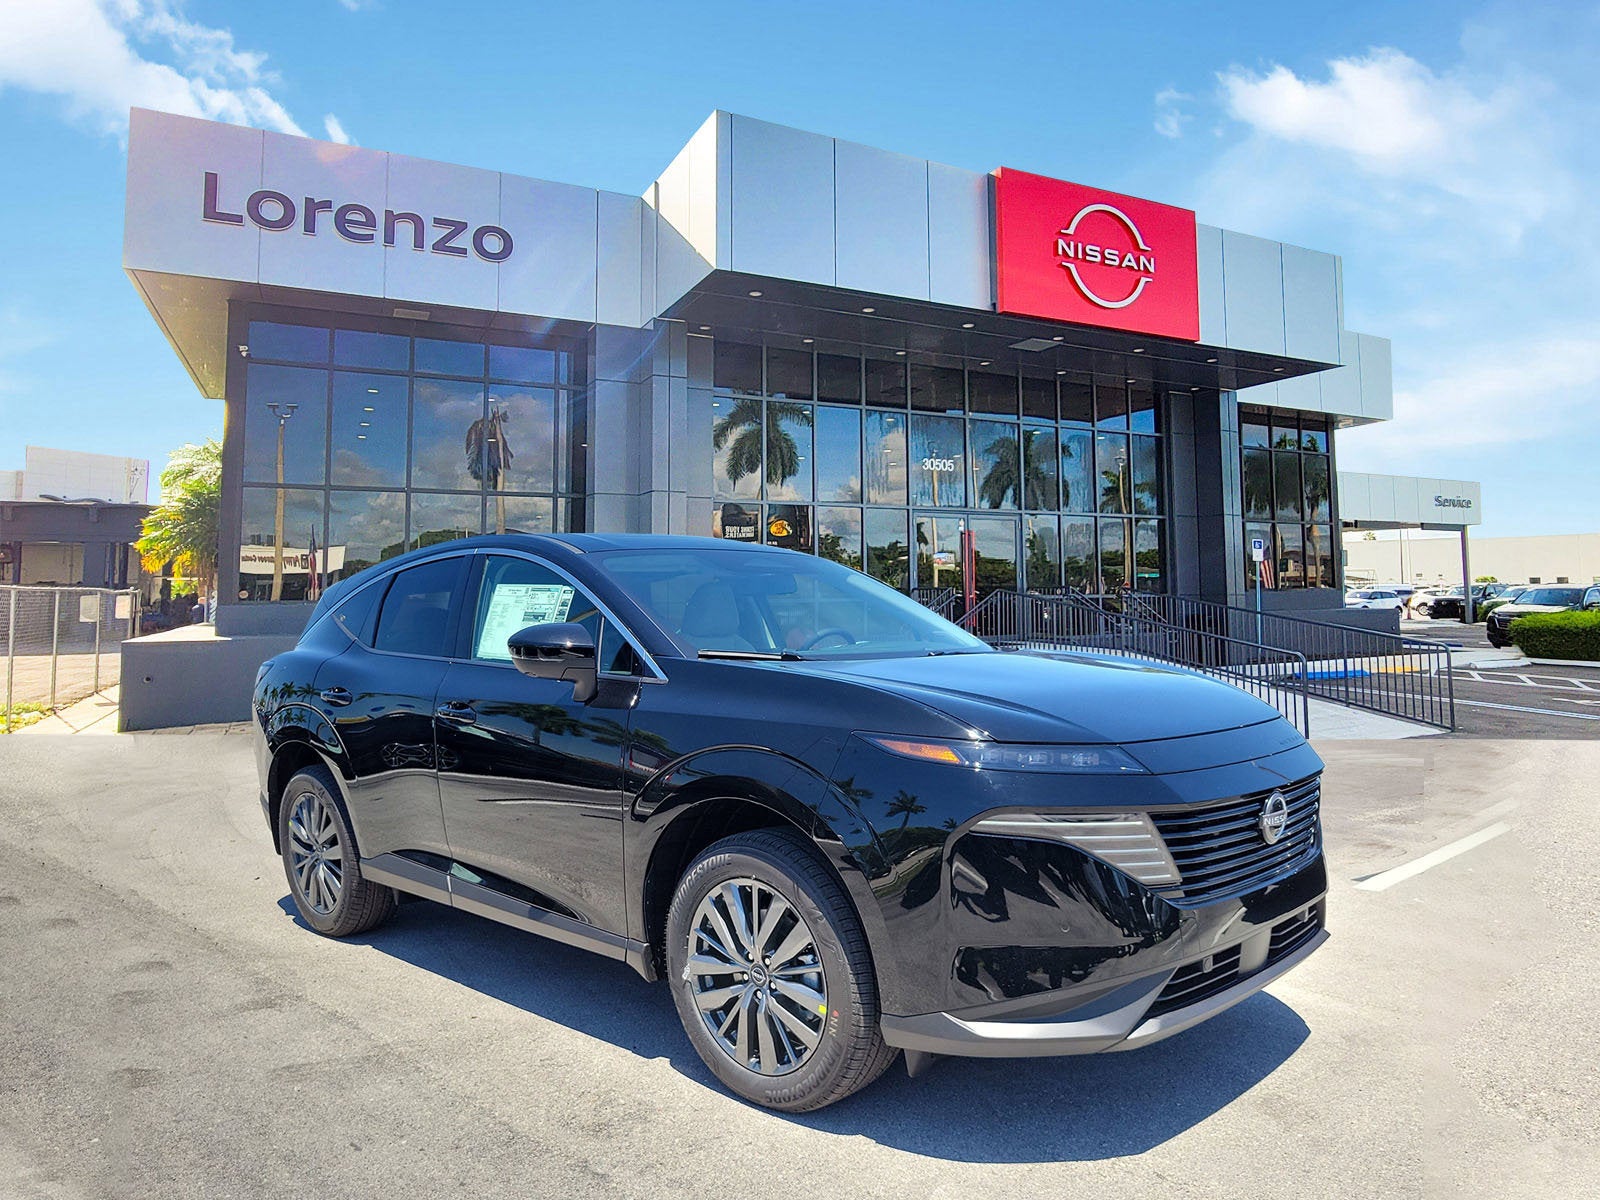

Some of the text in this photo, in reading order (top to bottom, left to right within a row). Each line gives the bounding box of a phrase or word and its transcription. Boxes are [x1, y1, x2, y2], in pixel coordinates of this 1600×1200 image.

[202, 171, 514, 263] Lorenzo
[1057, 238, 1155, 273] NISSAN
[922, 457, 955, 472] 30505
[1434, 495, 1472, 509] Service
